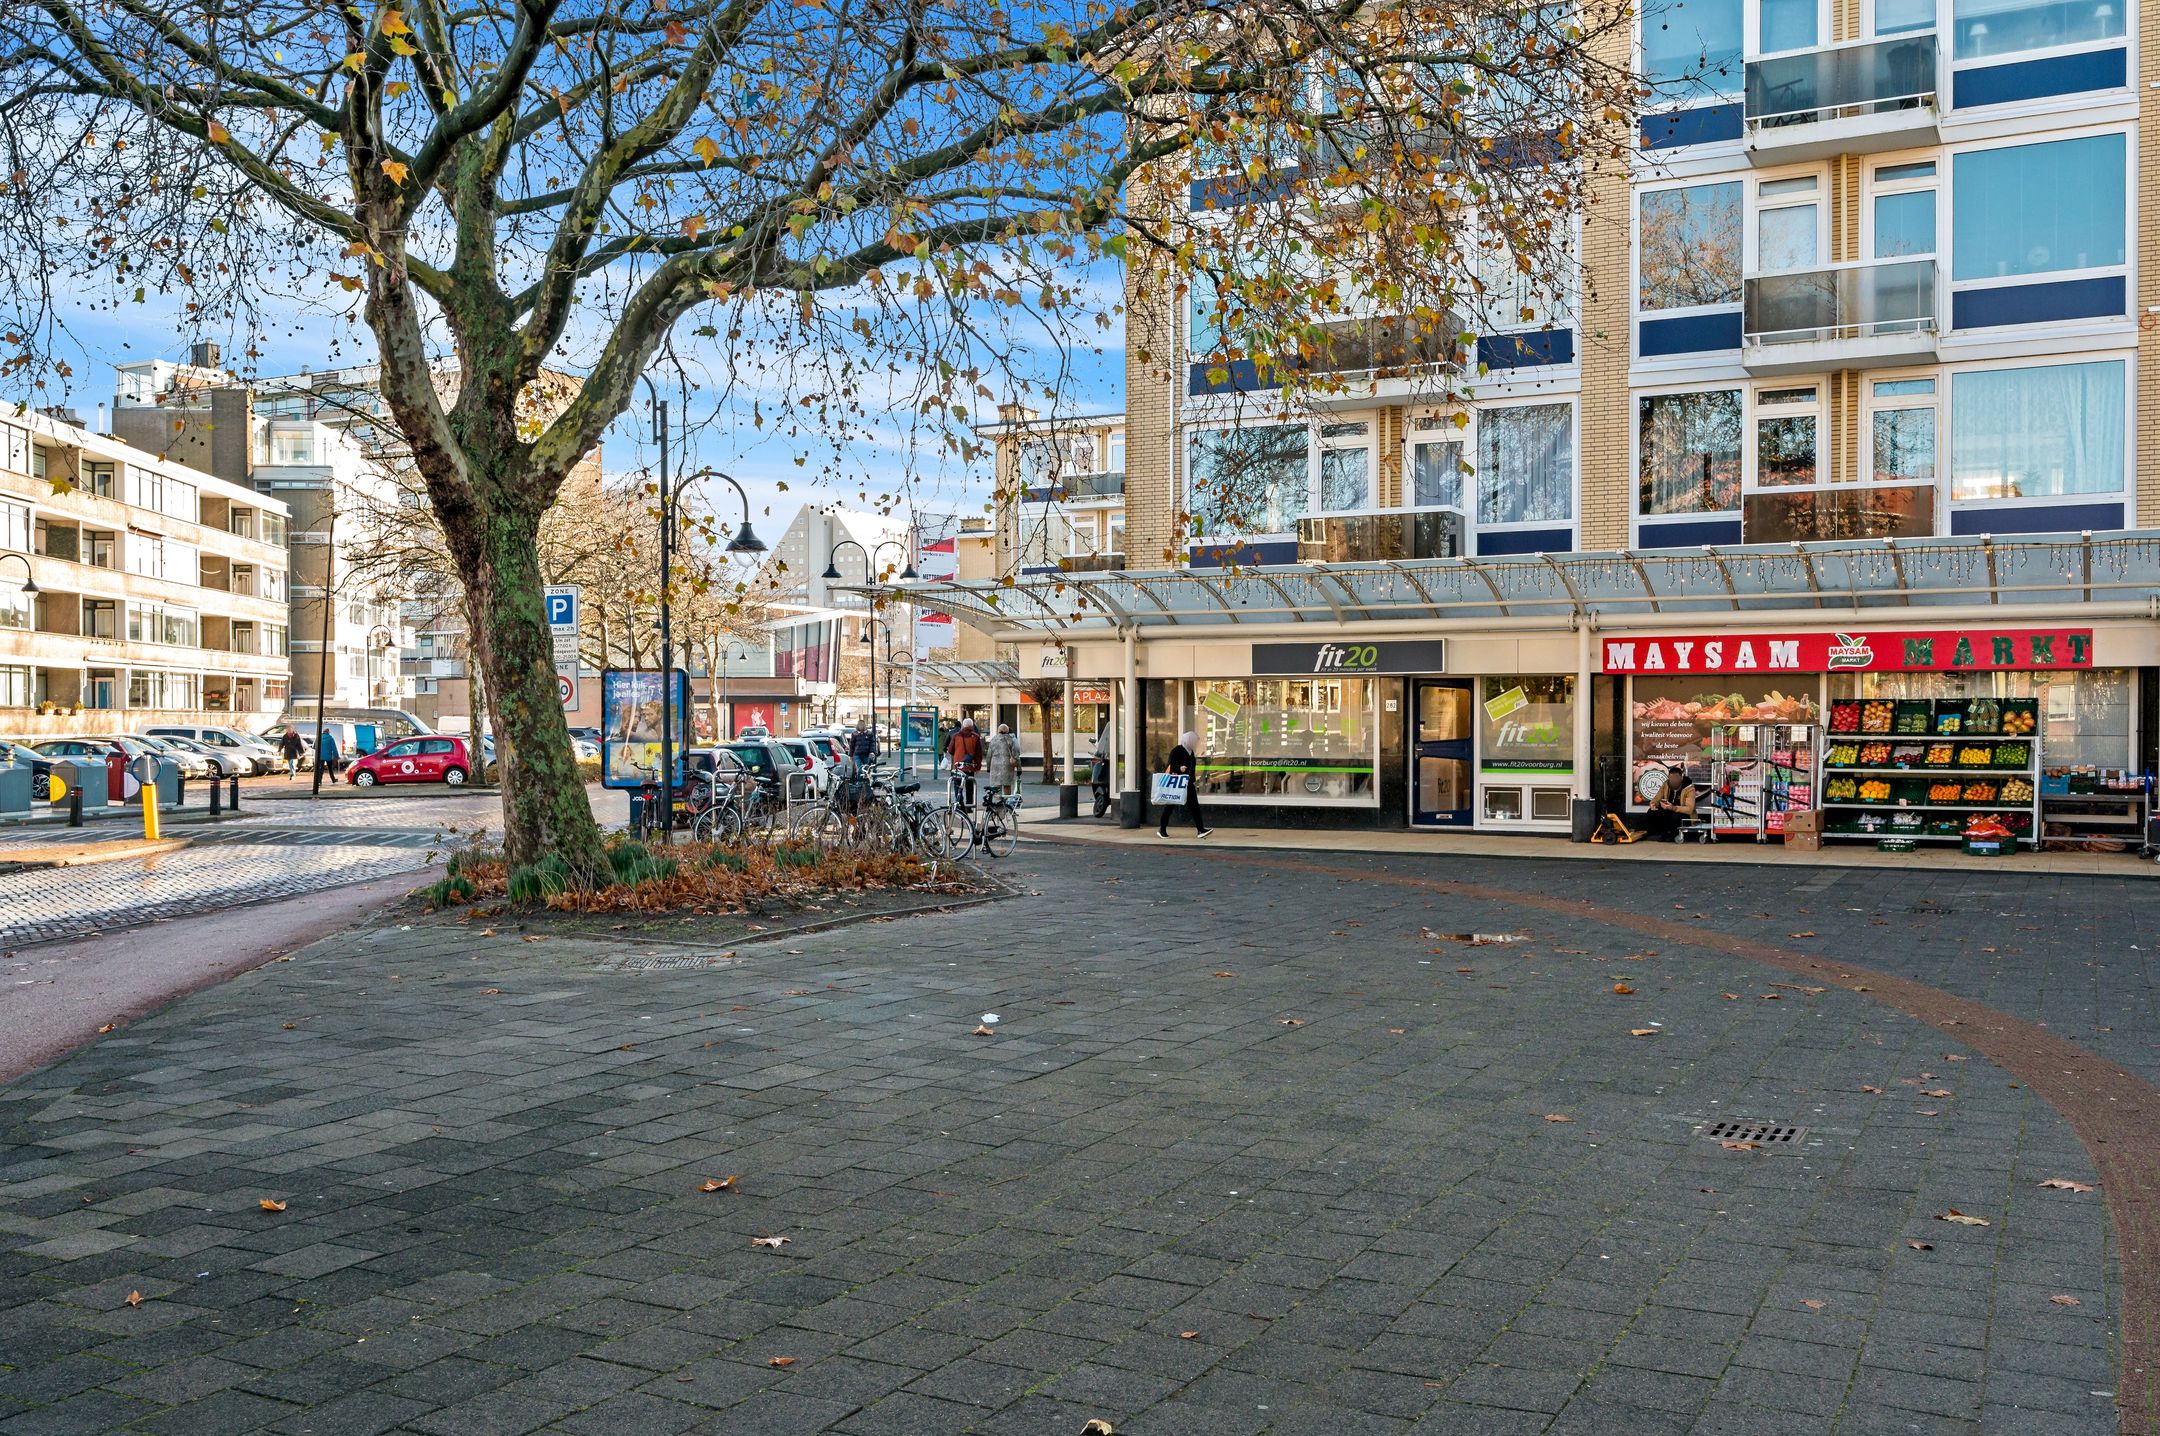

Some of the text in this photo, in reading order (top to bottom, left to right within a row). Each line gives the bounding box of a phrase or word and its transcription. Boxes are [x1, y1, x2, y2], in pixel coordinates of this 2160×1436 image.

[553, 599, 567, 621] P
[1607, 641, 1799, 669] MAYSAM
[1830, 647, 1869, 656] MAYSAM
[1903, 635, 2090, 666] MARKT
[1042, 656, 1067, 668] fit20
[1314, 644, 1377, 672] fit20
[561, 685, 568, 695] 0
[613, 681, 630, 689] Hier
[1083, 691, 1111, 701] PLAZ
[1497, 720, 1559, 747] fit20
[1249, 759, 1307, 768] voorburg@fit20.nl
[1492, 761, 1563, 769] www.fit20voorburg.nl
